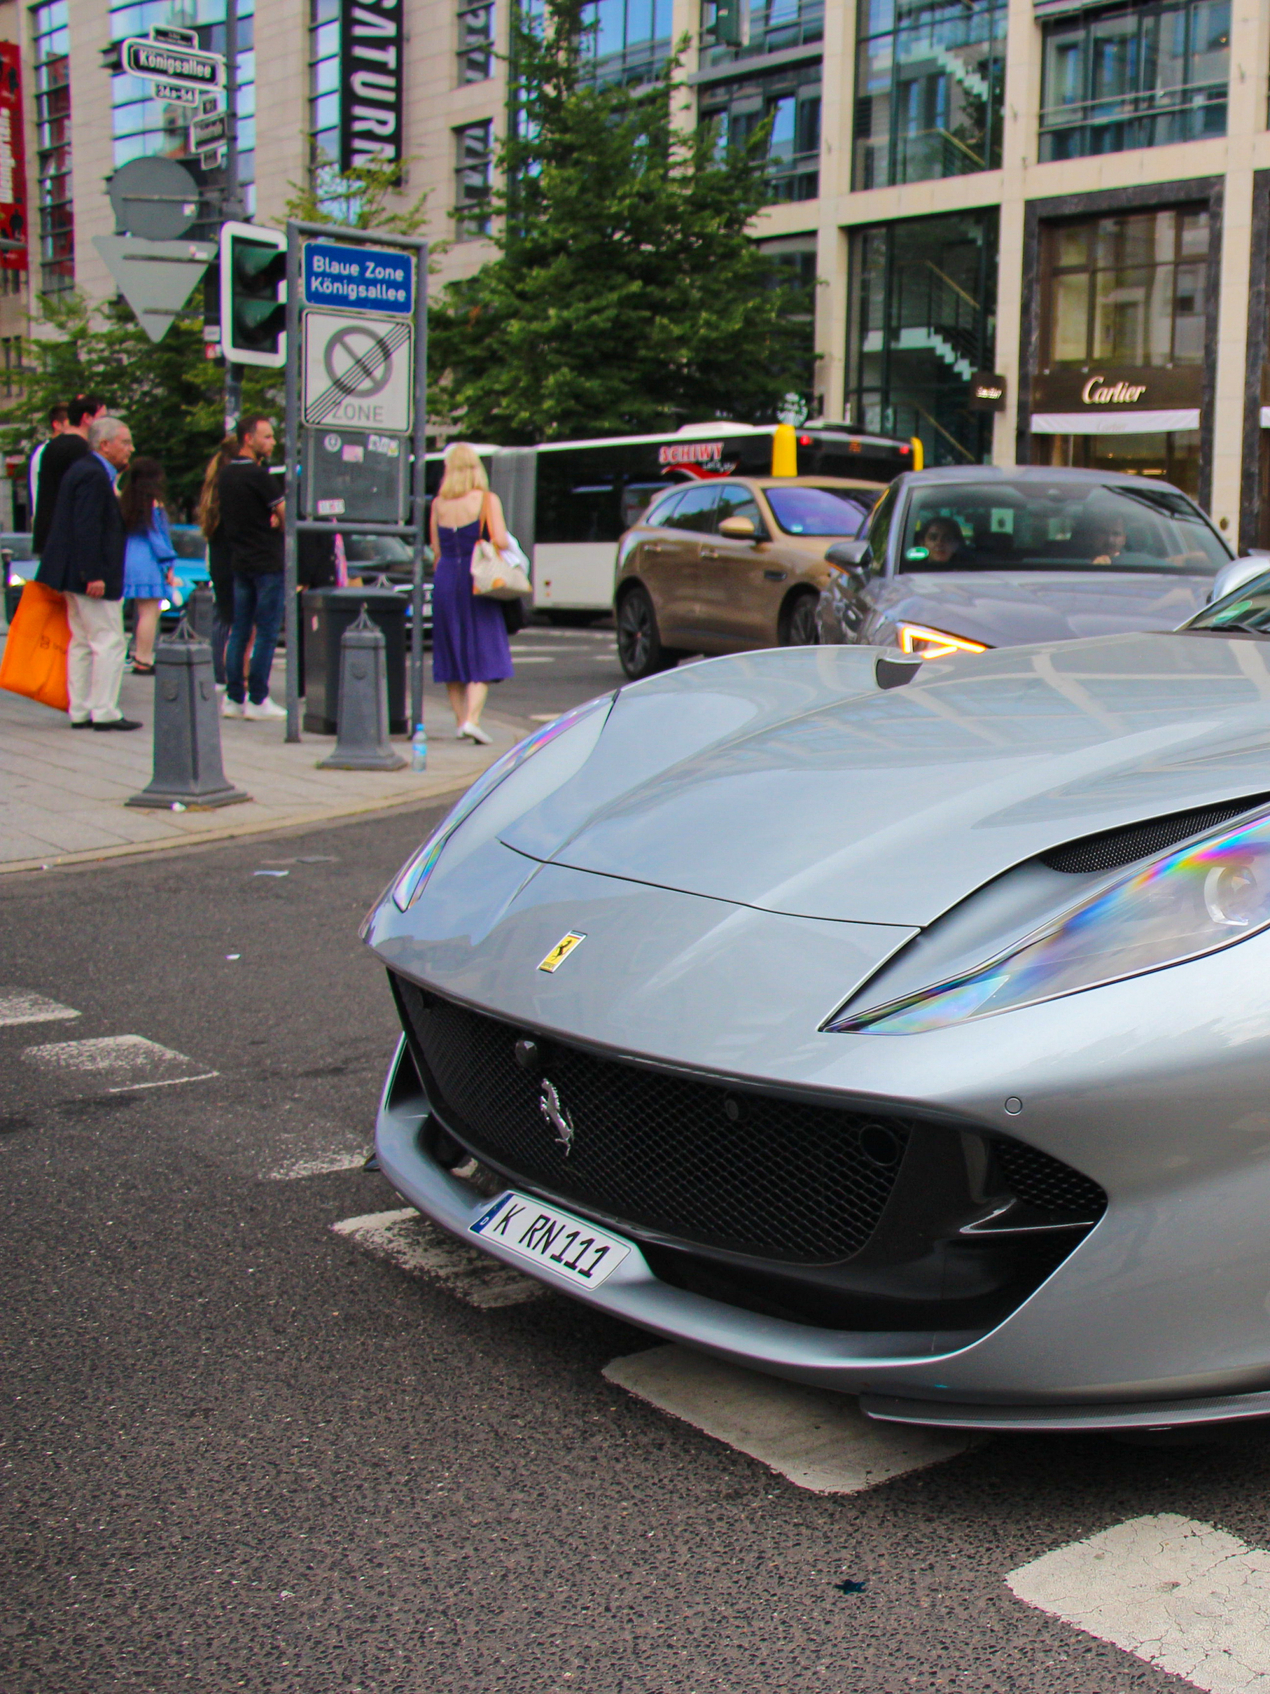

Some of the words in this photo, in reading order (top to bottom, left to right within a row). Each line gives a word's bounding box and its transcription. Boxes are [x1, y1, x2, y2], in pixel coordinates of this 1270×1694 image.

[139, 49, 212, 79] Königsallee
[312, 255, 360, 276] Blaue
[365, 262, 405, 282] Zone
[310, 276, 407, 302] Königsallee
[1082, 376, 1147, 404] Cartier
[331, 402, 384, 423] ZONE
[659, 442, 724, 464] SCHIWY
[493, 1203, 527, 1236] K
